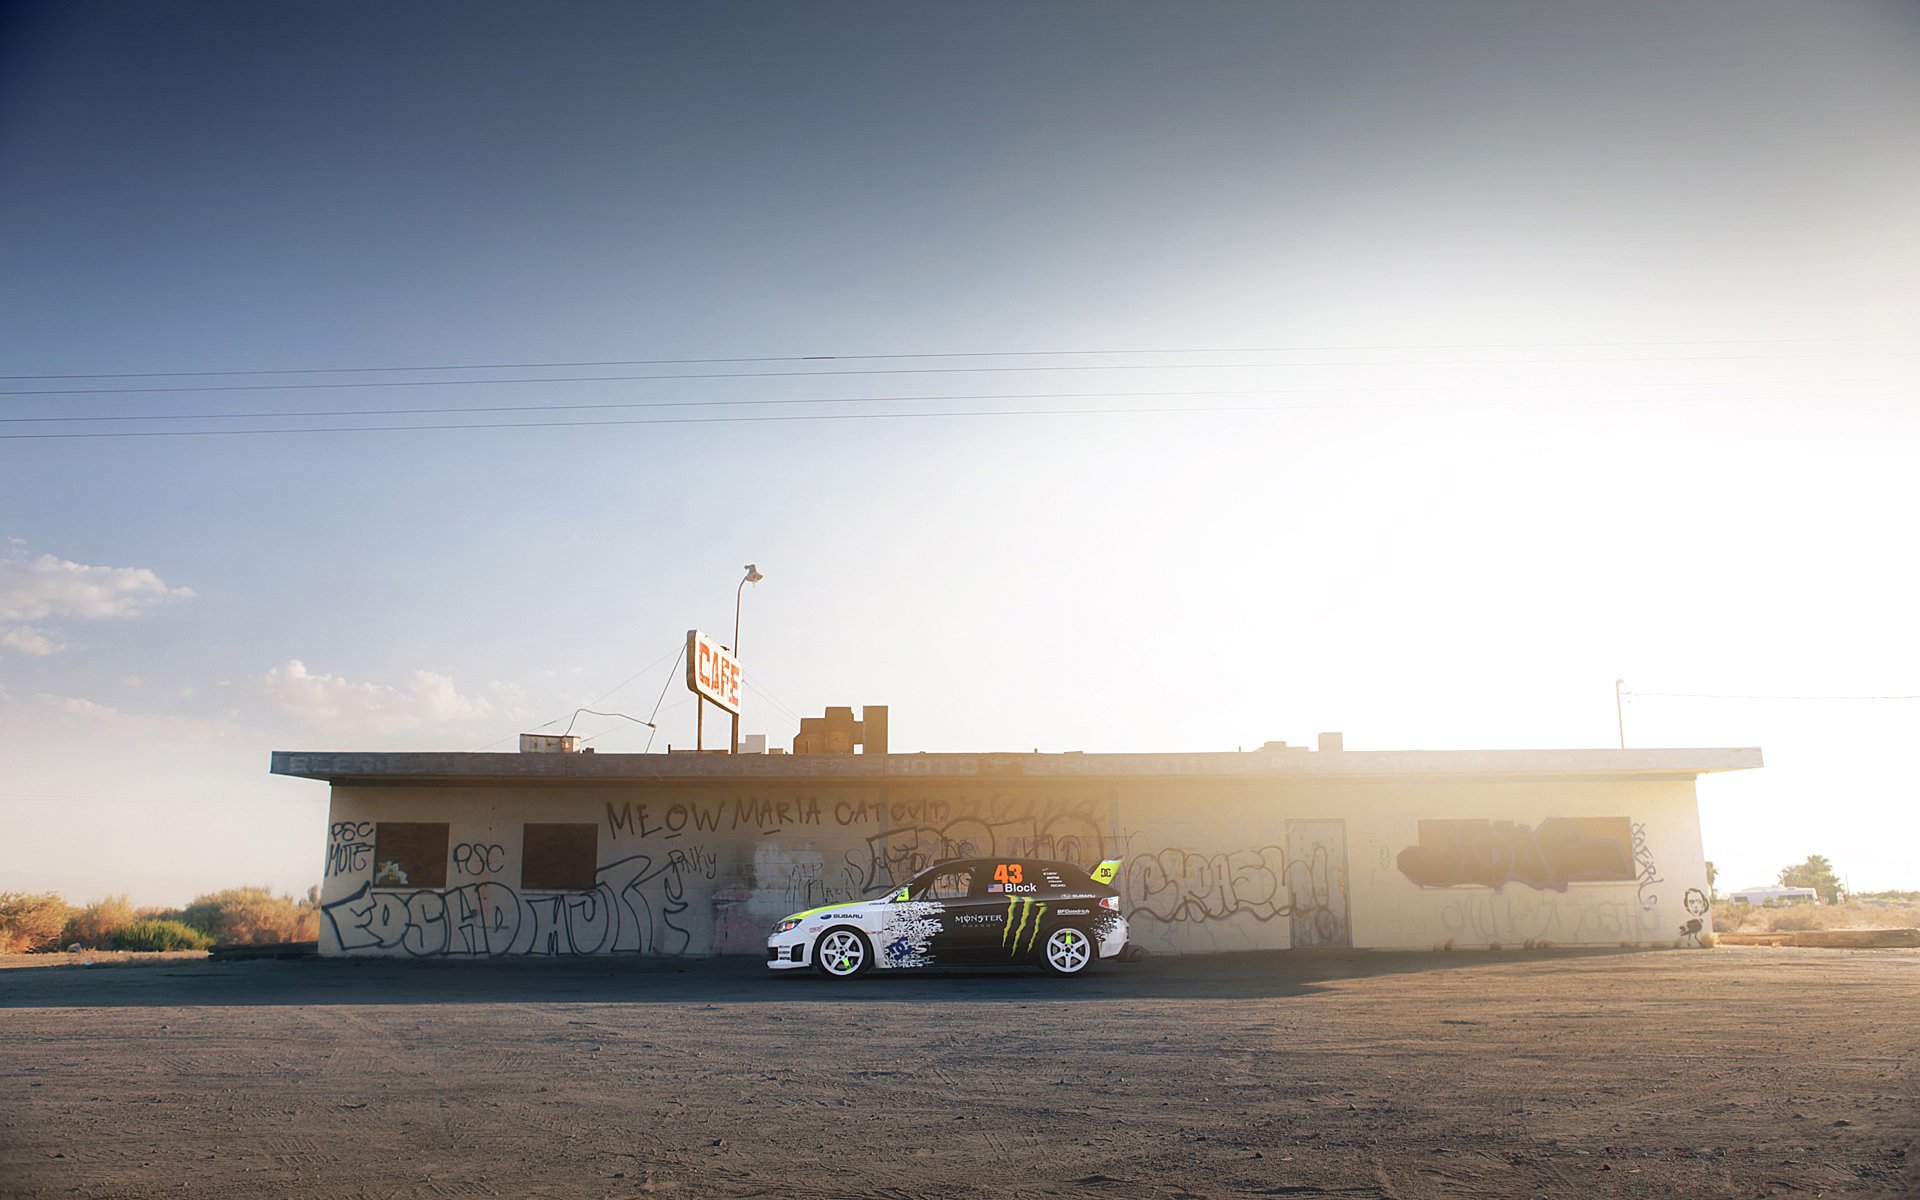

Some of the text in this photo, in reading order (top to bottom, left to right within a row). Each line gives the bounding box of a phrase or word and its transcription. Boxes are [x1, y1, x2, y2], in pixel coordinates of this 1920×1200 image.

[698, 641, 740, 707] CAFE
[606, 800, 725, 839] MEOW
[731, 797, 822, 836] MARIA
[834, 799, 887, 826] CAT
[993, 863, 1023, 884] 43
[1004, 883, 1037, 893] Block
[955, 914, 1003, 924] MONSTER
